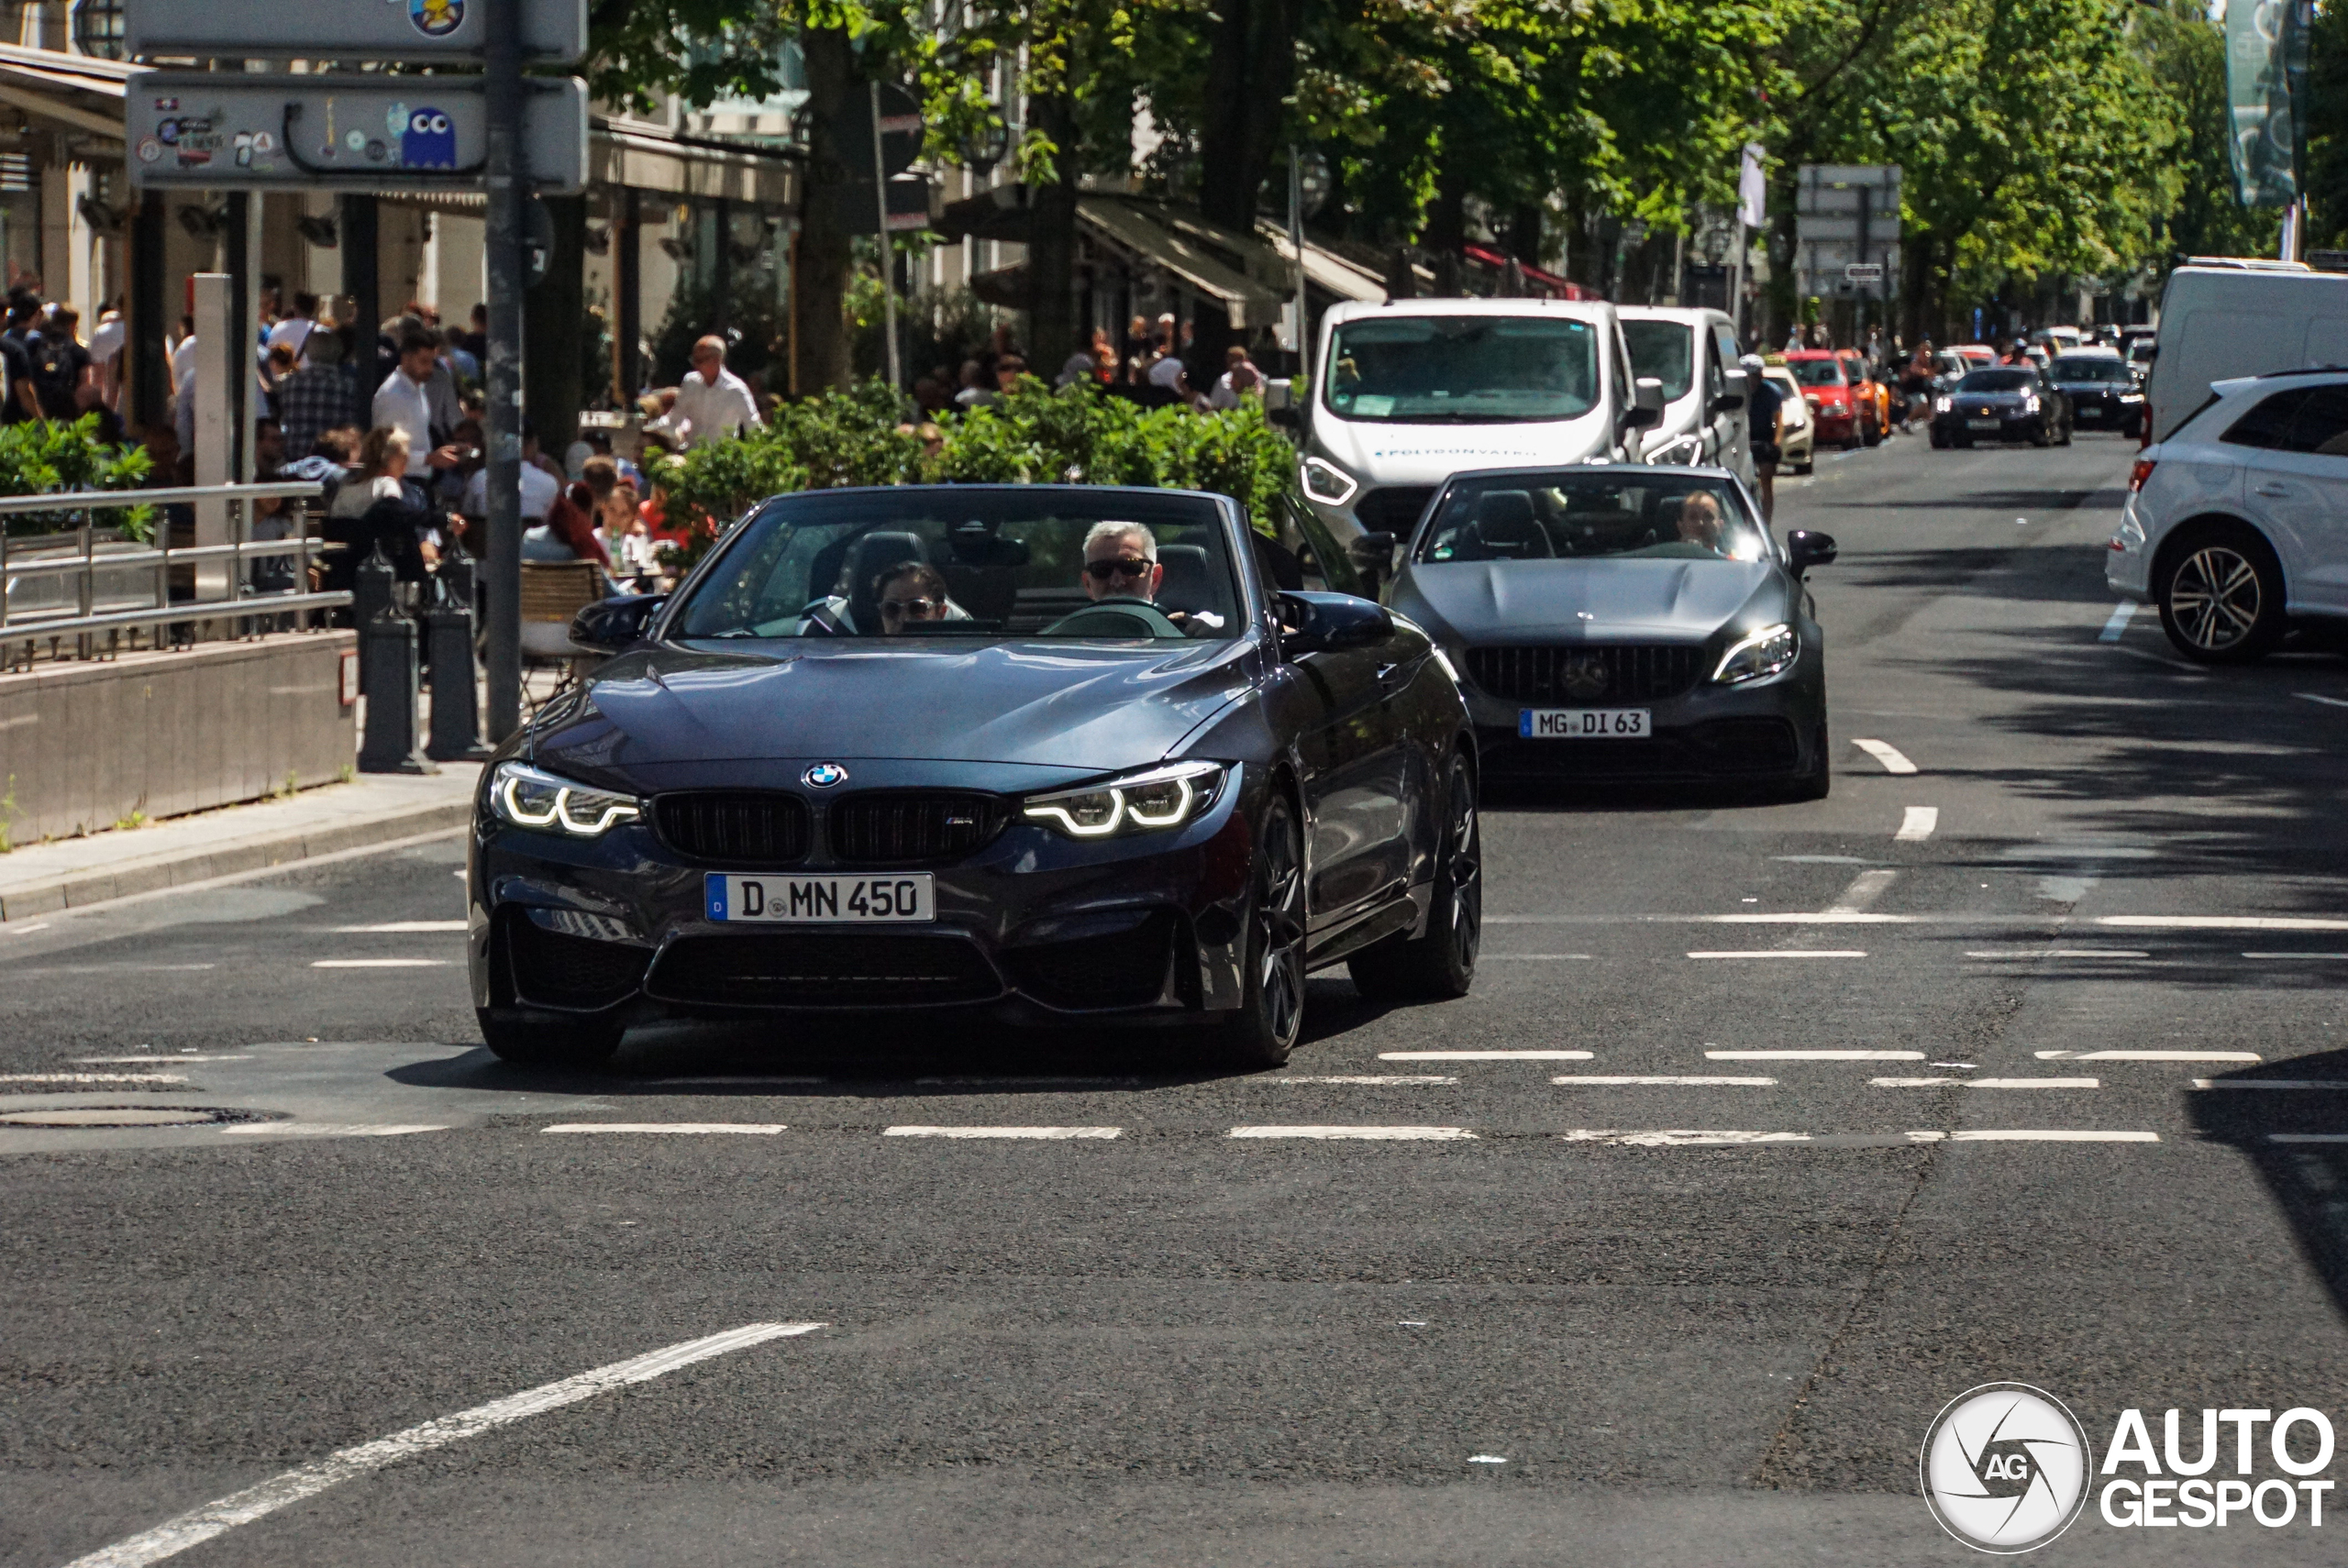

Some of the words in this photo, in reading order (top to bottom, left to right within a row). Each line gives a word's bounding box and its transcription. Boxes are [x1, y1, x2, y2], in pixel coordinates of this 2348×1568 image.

[1539, 713, 1567, 734] MG
[1582, 713, 1608, 734] DI
[1614, 713, 1641, 734] 63
[714, 902, 722, 912] D
[741, 881, 764, 916] D
[790, 881, 838, 917] MN
[847, 880, 917, 917] 450
